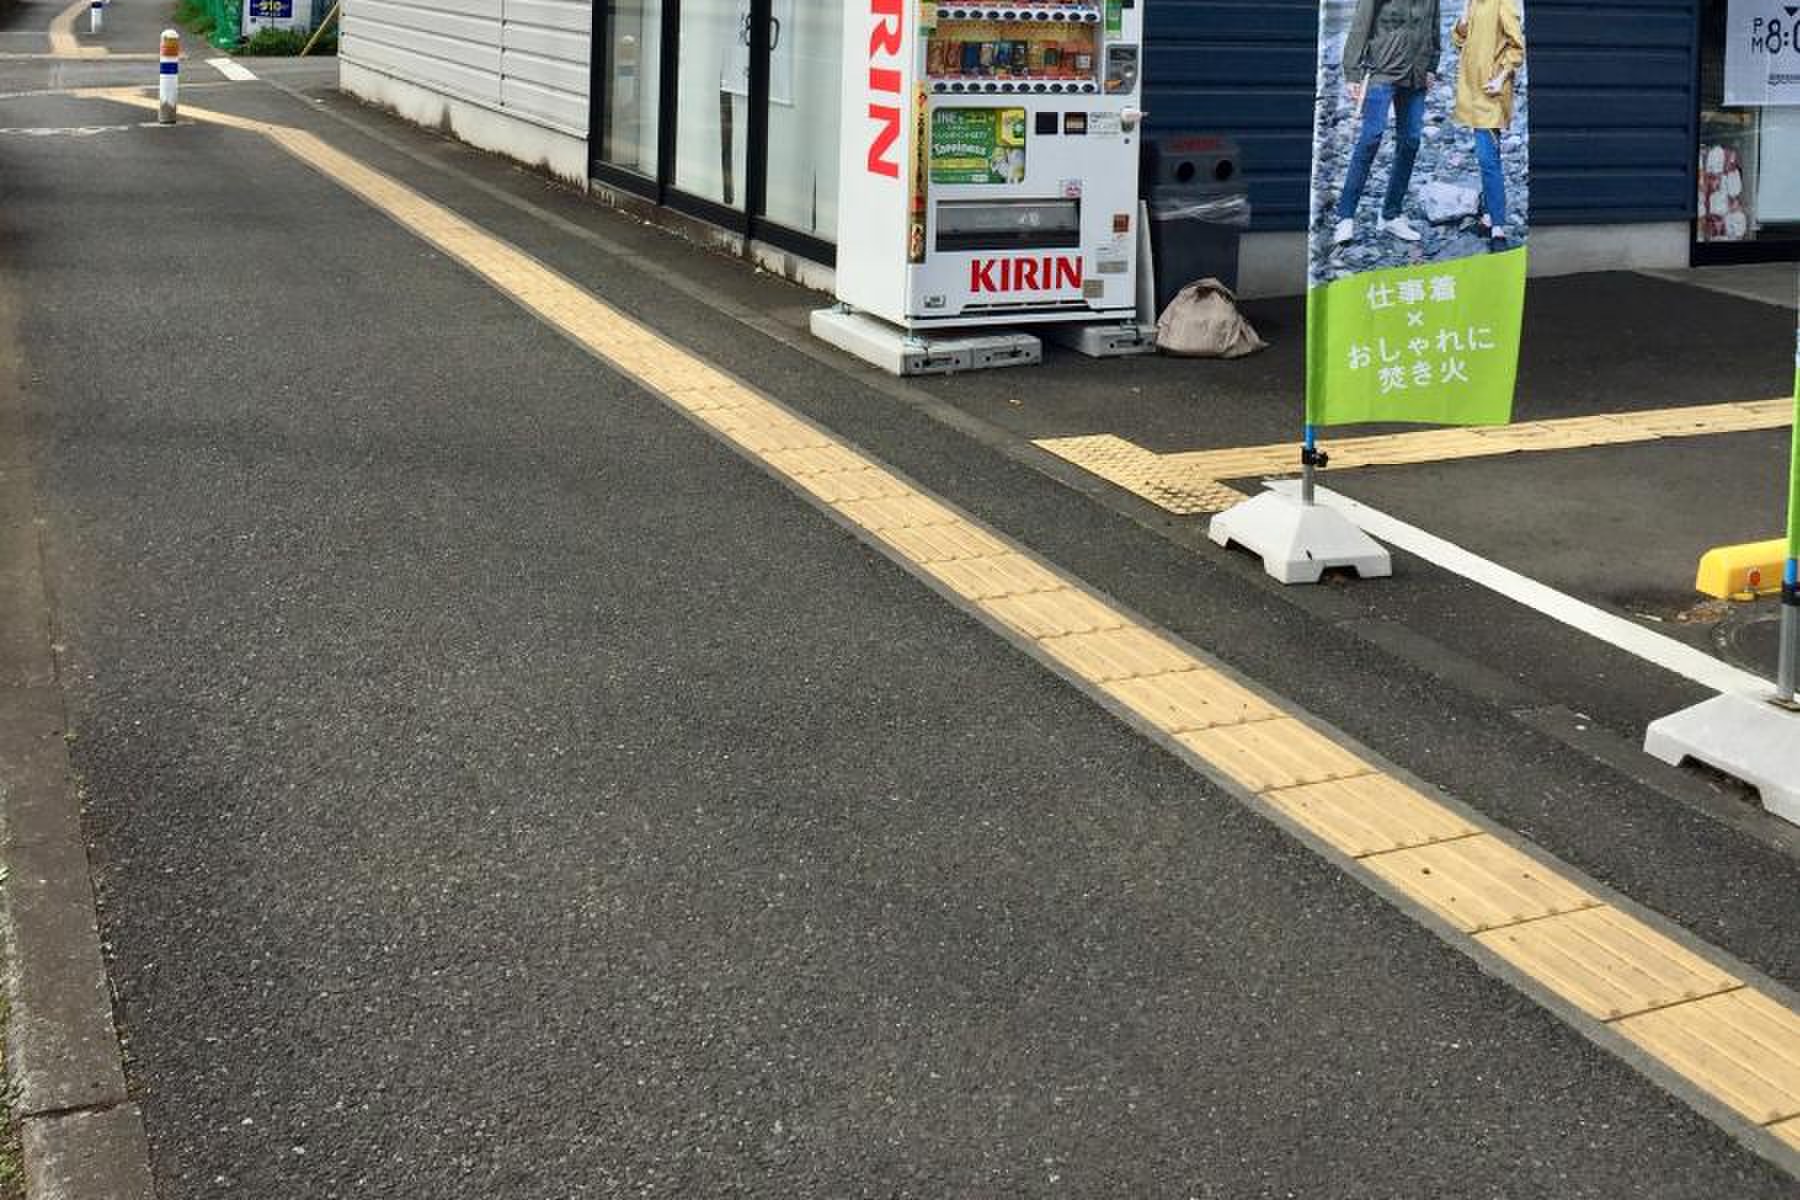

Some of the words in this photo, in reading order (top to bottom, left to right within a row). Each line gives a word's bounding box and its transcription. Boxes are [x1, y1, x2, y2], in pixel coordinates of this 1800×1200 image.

[970, 256, 1083, 292] KIRIN
[1367, 276, 1457, 310] 仕事着
[1348, 326, 1494, 369] おしゃれに
[1379, 358, 1469, 394] 焚き火
